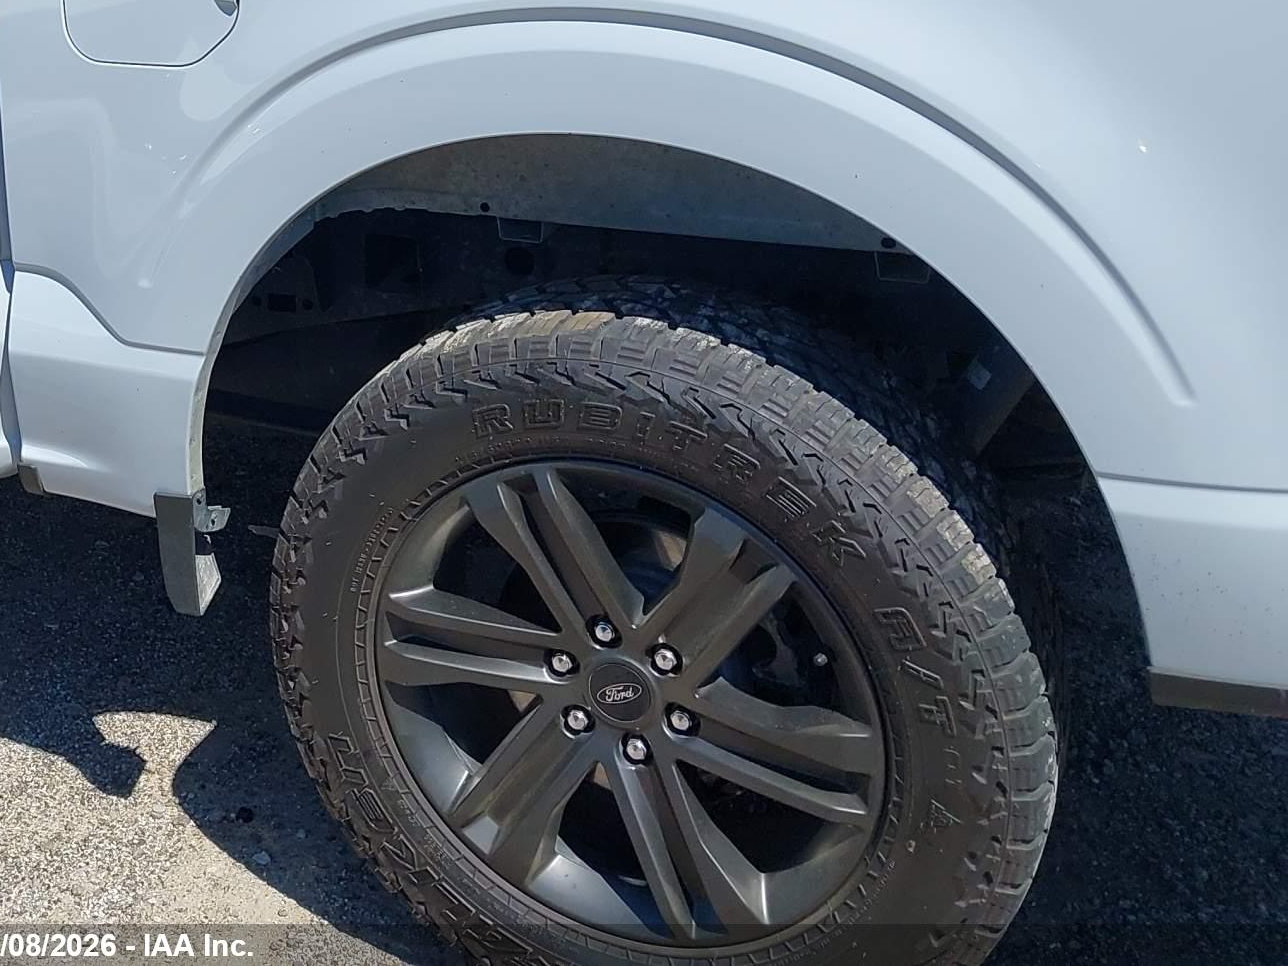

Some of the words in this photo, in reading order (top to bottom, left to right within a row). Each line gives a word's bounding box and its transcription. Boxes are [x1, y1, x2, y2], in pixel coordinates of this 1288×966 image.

[472, 398, 867, 567] RUBITREK
[605, 685, 634, 702] Ford
[327, 732, 550, 966] ALKEN
